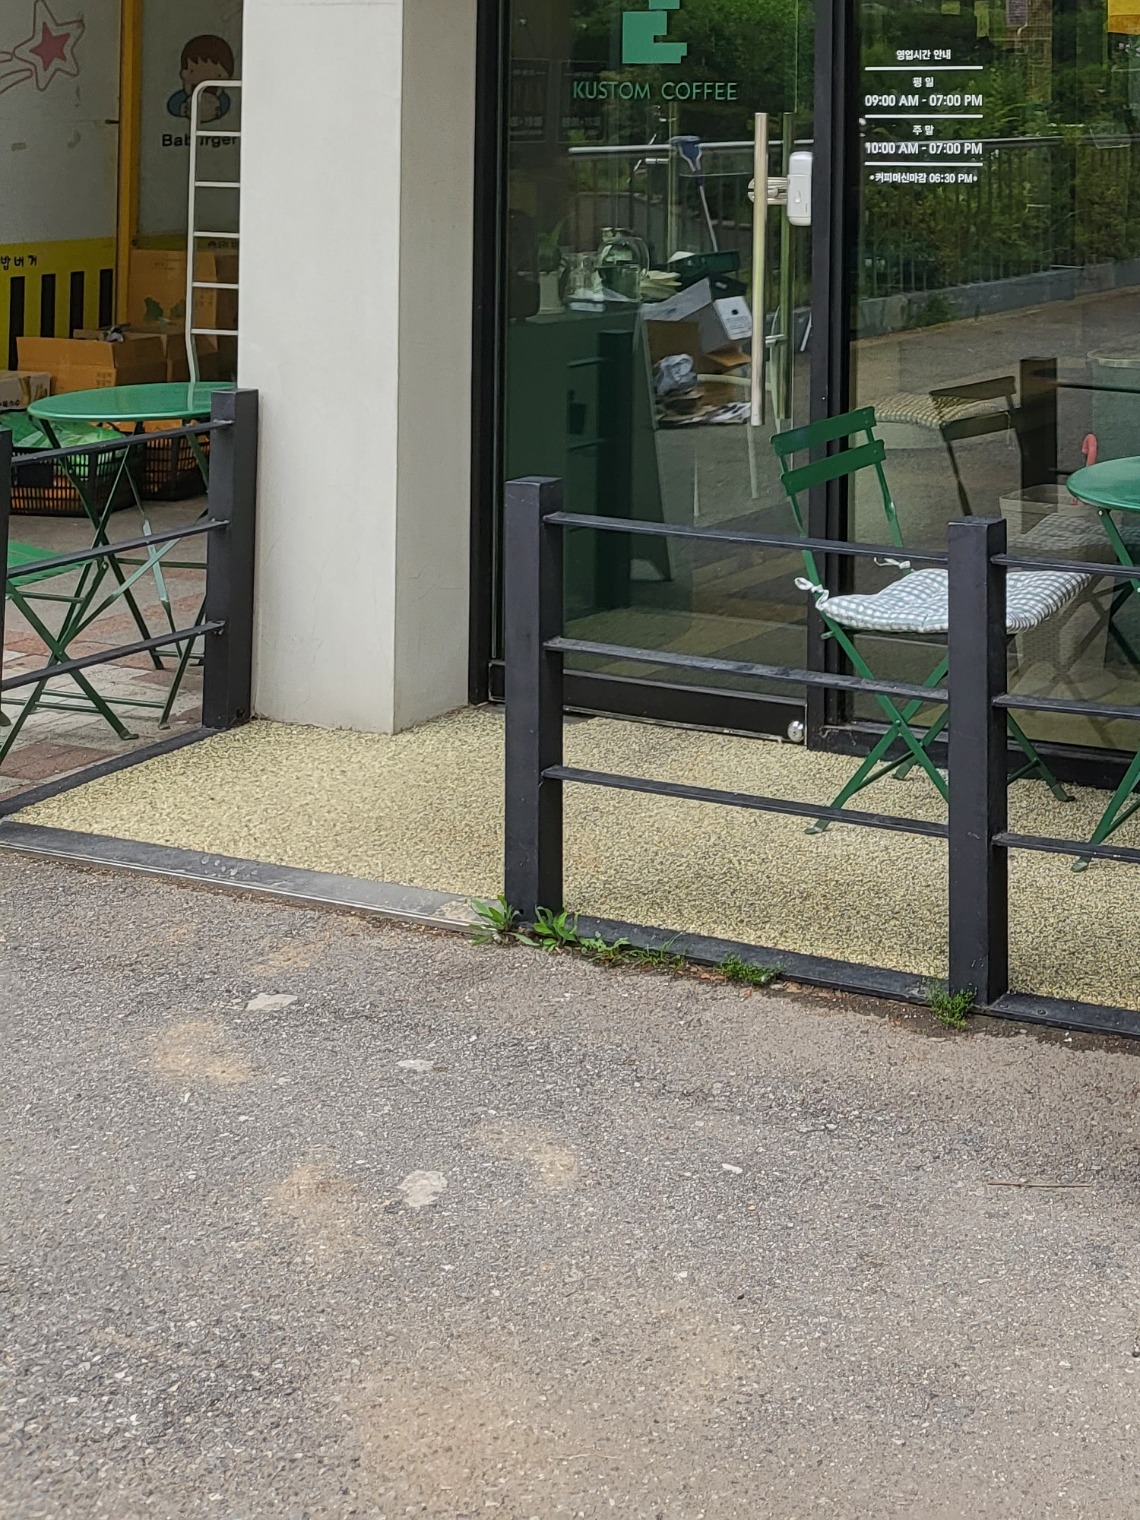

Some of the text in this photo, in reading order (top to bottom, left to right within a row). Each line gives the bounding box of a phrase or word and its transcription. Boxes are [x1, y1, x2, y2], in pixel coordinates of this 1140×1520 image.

[896, 49, 951, 60] 영업시간 안내
[573, 81, 738, 100] KUSTOM COFFEE
[864, 95, 896, 106] 09:00
[899, 95, 919, 106] AM
[929, 95, 961, 106] 07:00
[964, 95, 983, 106] PM
[865, 143, 896, 154] 10:00
[899, 143, 919, 154] AM
[929, 143, 961, 154] 07:00
[964, 143, 983, 154] PM
